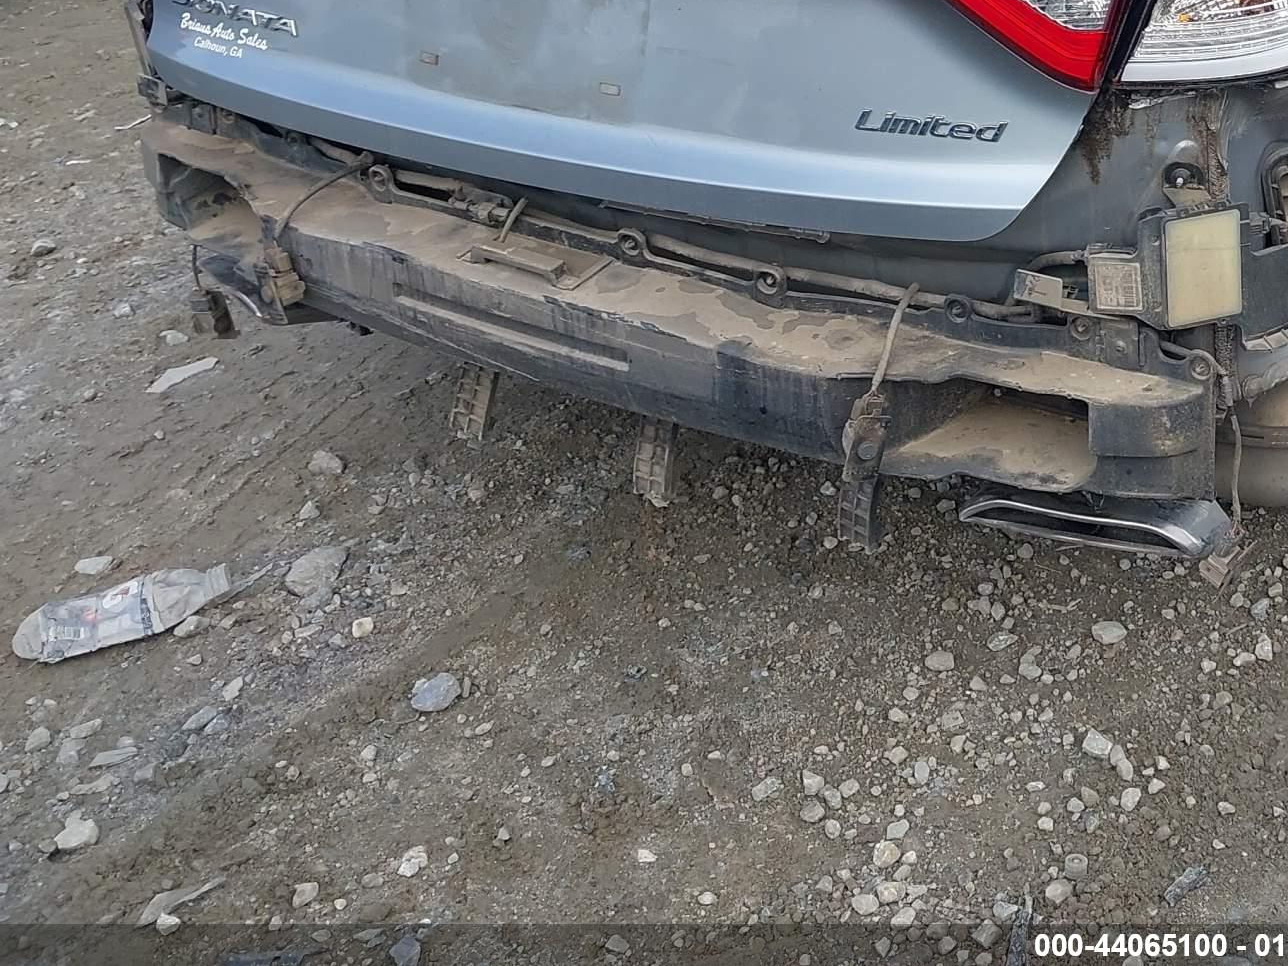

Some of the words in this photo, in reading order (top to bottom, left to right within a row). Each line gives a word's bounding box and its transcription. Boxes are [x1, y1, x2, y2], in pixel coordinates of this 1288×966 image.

[193, 36, 228, 56] Calhoun,
[229, 46, 243, 59] GA
[211, 22, 235, 41] Auto
[237, 28, 268, 51] Sales
[854, 108, 1009, 143] Limited
